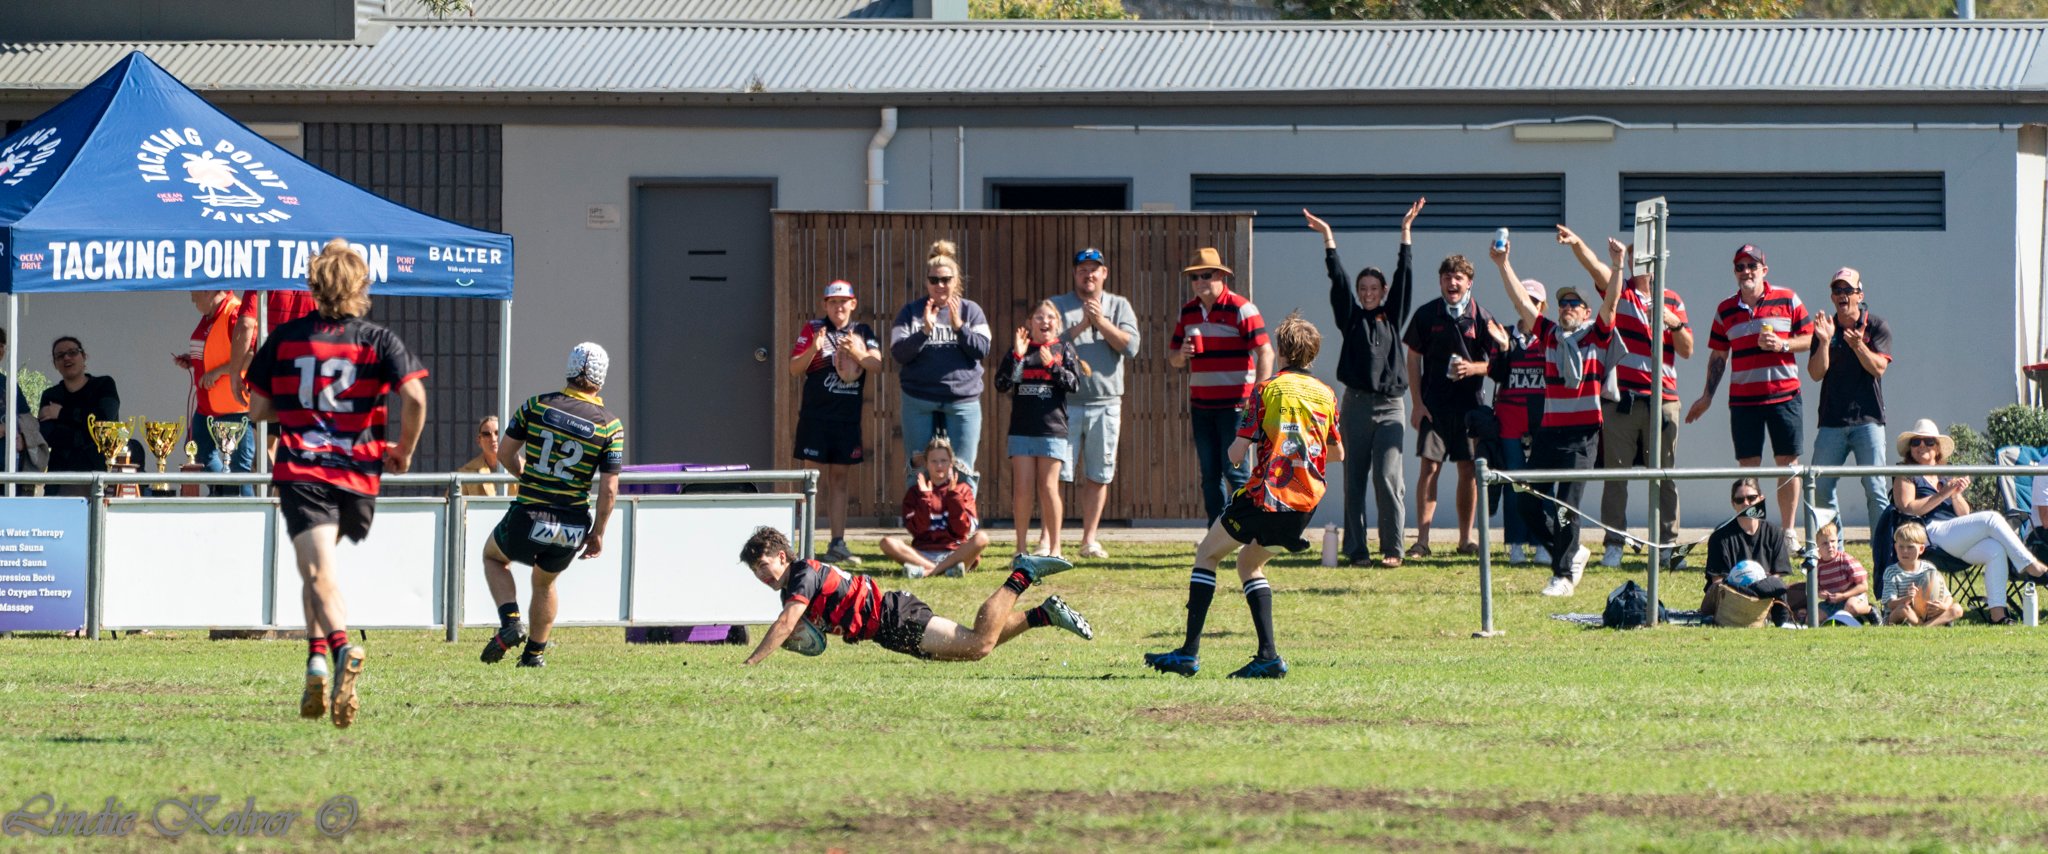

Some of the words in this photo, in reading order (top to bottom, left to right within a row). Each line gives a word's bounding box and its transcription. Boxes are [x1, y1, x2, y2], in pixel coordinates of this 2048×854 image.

[137, 128, 203, 182] TACKING
[215, 139, 288, 190] POINT
[201, 207, 292, 224] TAVERN
[20, 254, 44, 262] OCEAN
[49, 240, 175, 280] TACKING
[184, 239, 270, 279] POINT
[396, 256, 415, 265] PORT
[429, 247, 502, 264] BALTER
[21, 262, 42, 270] DRIVE
[397, 264, 413, 273] MAC
[294, 356, 357, 411] 12
[1509, 374, 1546, 389] PLAZA
[533, 430, 584, 480] 12
[6, 528, 29, 537] Water
[31, 528, 64, 539] Therapy
[19, 543, 44, 552] Sauna
[22, 558, 47, 567] Sauna
[32, 573, 55, 582] Boots
[7, 588, 37, 599] Oxygen
[39, 588, 72, 599] Therapy
[0, 602, 34, 613] Massage
